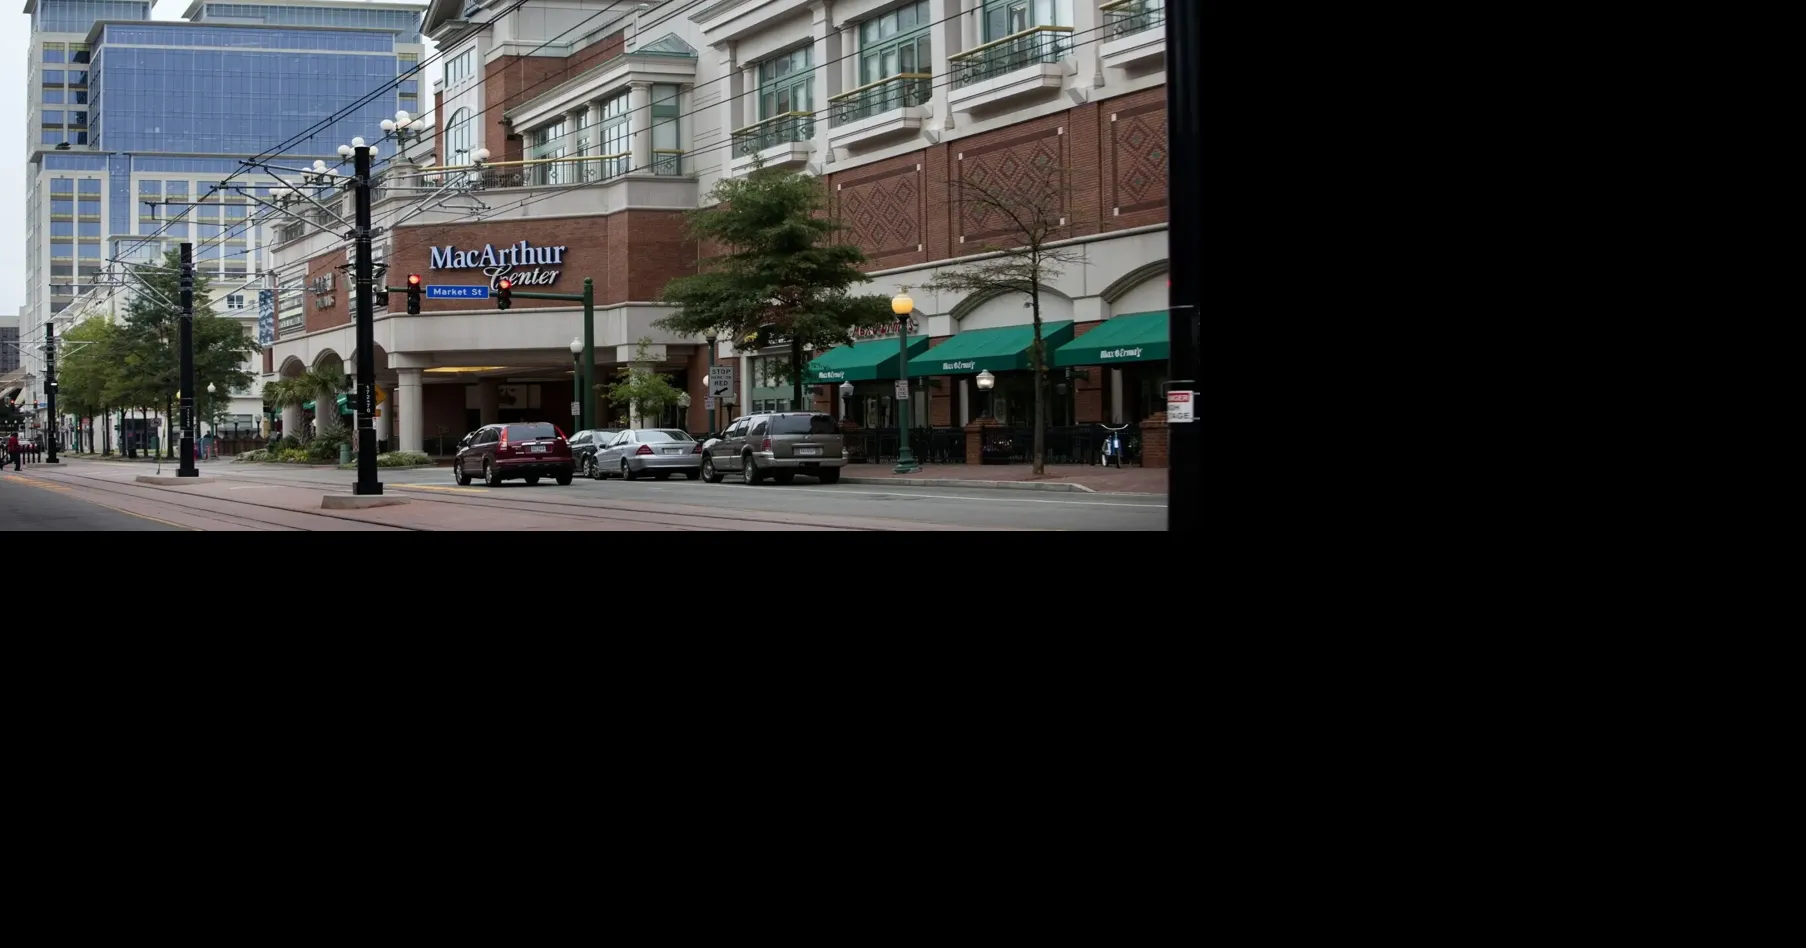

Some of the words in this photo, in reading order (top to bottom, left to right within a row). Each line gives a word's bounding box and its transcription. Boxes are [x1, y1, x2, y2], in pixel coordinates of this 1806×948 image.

[429, 240, 566, 269] MacArthur
[483, 264, 560, 291] Center
[433, 288, 467, 296] Market
[471, 288, 482, 296] St
